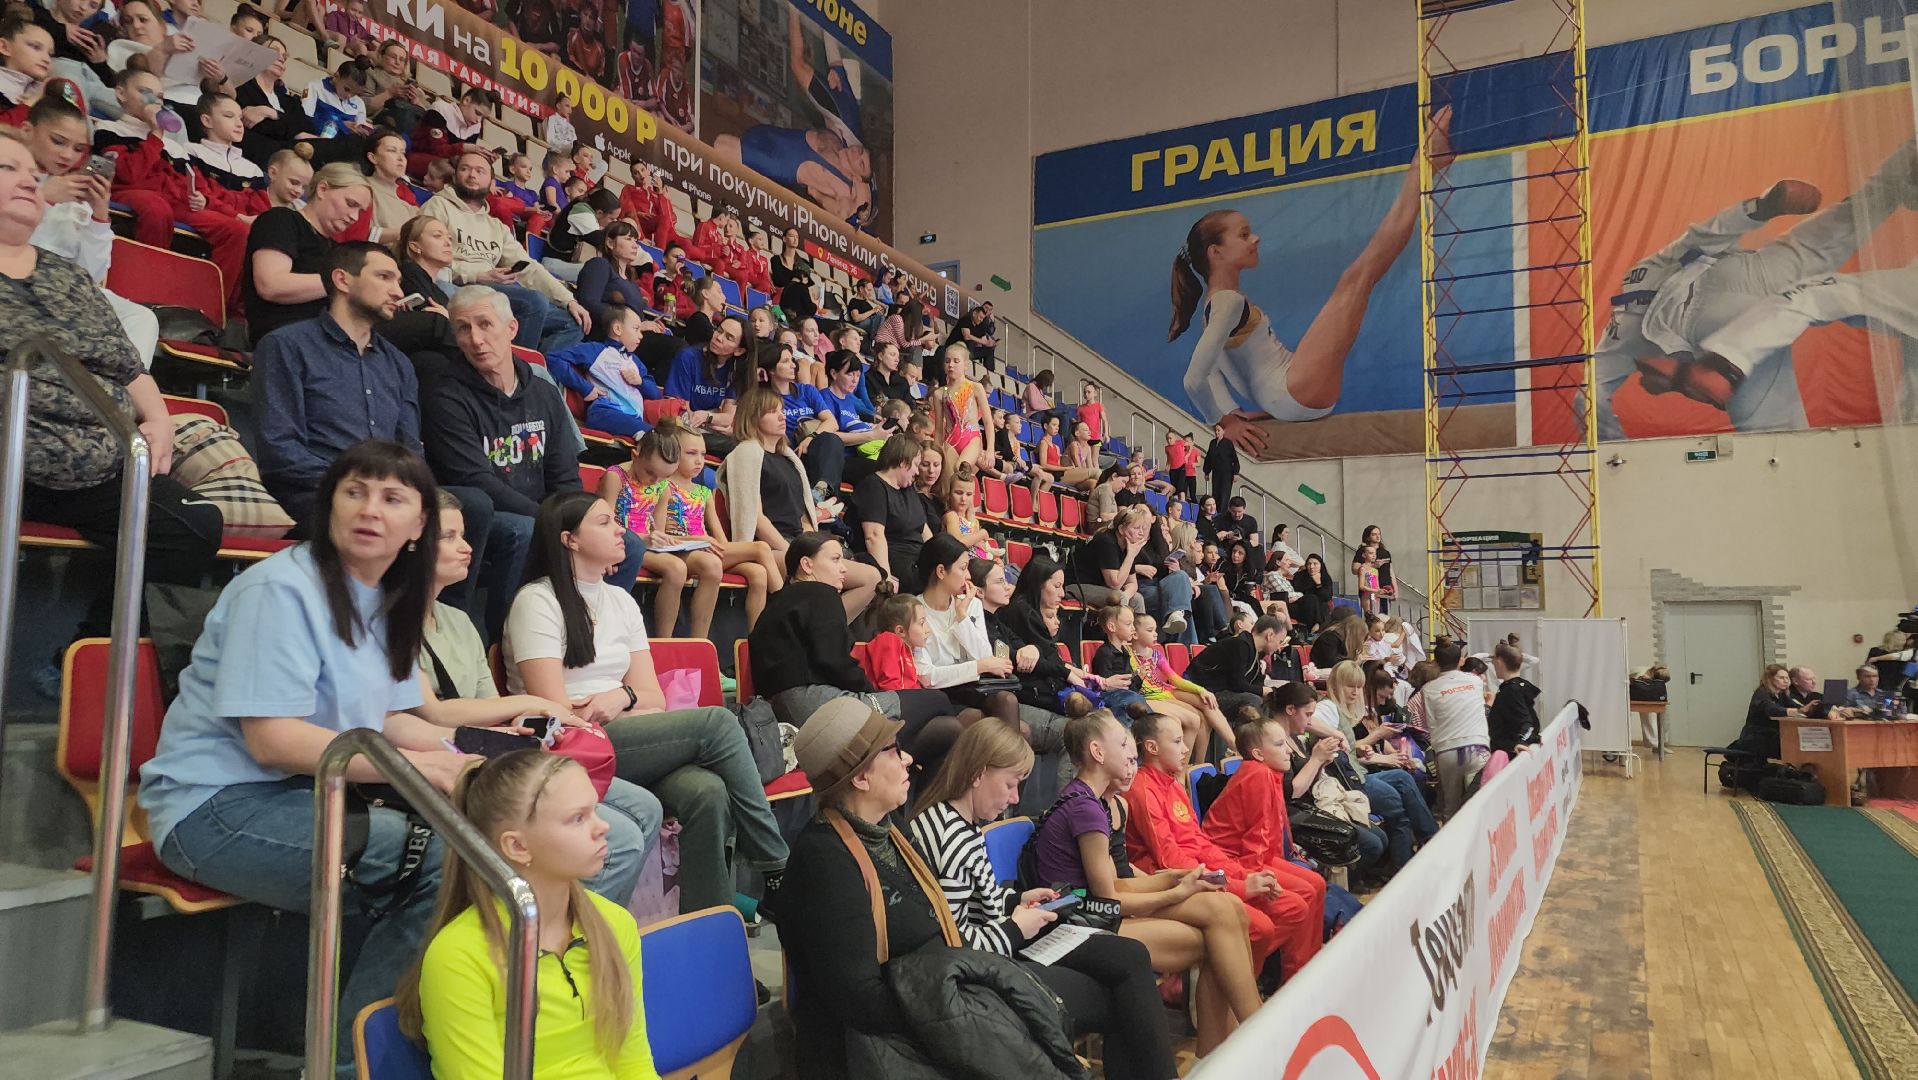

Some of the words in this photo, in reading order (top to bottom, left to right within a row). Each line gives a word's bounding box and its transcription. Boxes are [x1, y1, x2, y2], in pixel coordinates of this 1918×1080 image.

[807, 0, 867, 45] оне
[449, 58, 540, 116] ГАРАНТИЯ
[386, 0, 445, 40] КИ
[453, 24, 492, 66] на
[500, 36, 549, 91] 10
[555, 67, 629, 133] 000
[663, 137, 703, 176] при
[709, 163, 789, 222] покупки
[793, 201, 847, 253] iPhone
[851, 240, 877, 269] или
[606, 141, 632, 161] Apple
[1131, 109, 1377, 192] ГРАЦИЯ
[1086, 900, 1121, 915] HUGO
